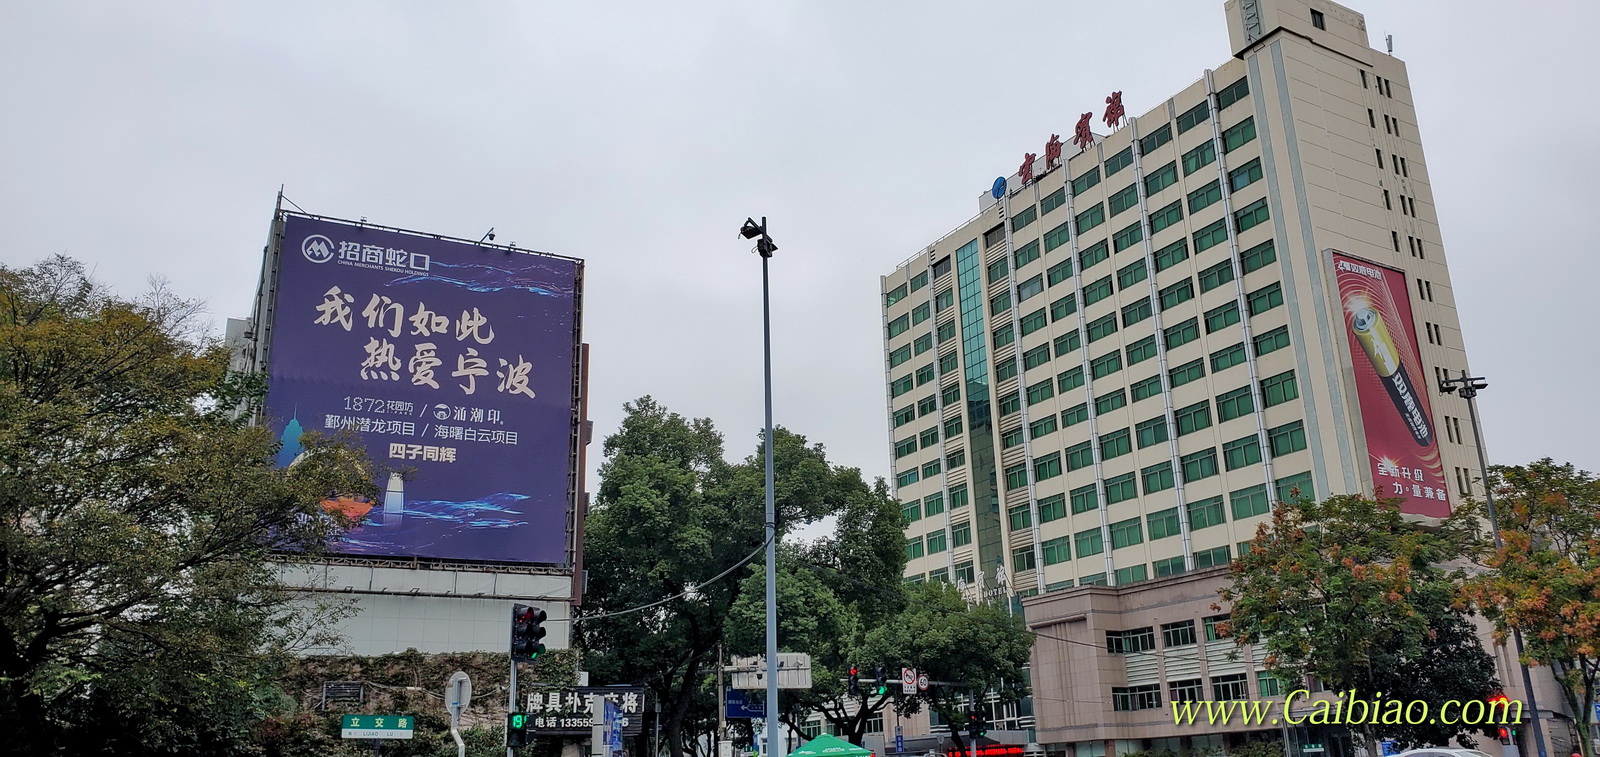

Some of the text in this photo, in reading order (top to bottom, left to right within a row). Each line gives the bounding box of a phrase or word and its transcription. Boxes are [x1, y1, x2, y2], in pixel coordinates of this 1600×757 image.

[337, 259, 353, 267] CHINA
[354, 262, 384, 271] MERCHANTS
[384, 266, 404, 274] SHEKOU
[338, 241, 430, 271] 招商蛇口
[313, 285, 495, 345] 我们如此
[360, 336, 536, 400] 热爱宁波
[324, 413, 415, 436] 鄞州潜龙项目
[434, 424, 518, 445] 海曙白云项目
[389, 442, 457, 464] 四子同辉
[1377, 462, 1424, 482] 全新升级
[983, 586, 1007, 599] HOTEL
[350, 716, 408, 729] 立交路
[534, 716, 557, 728] 电话
